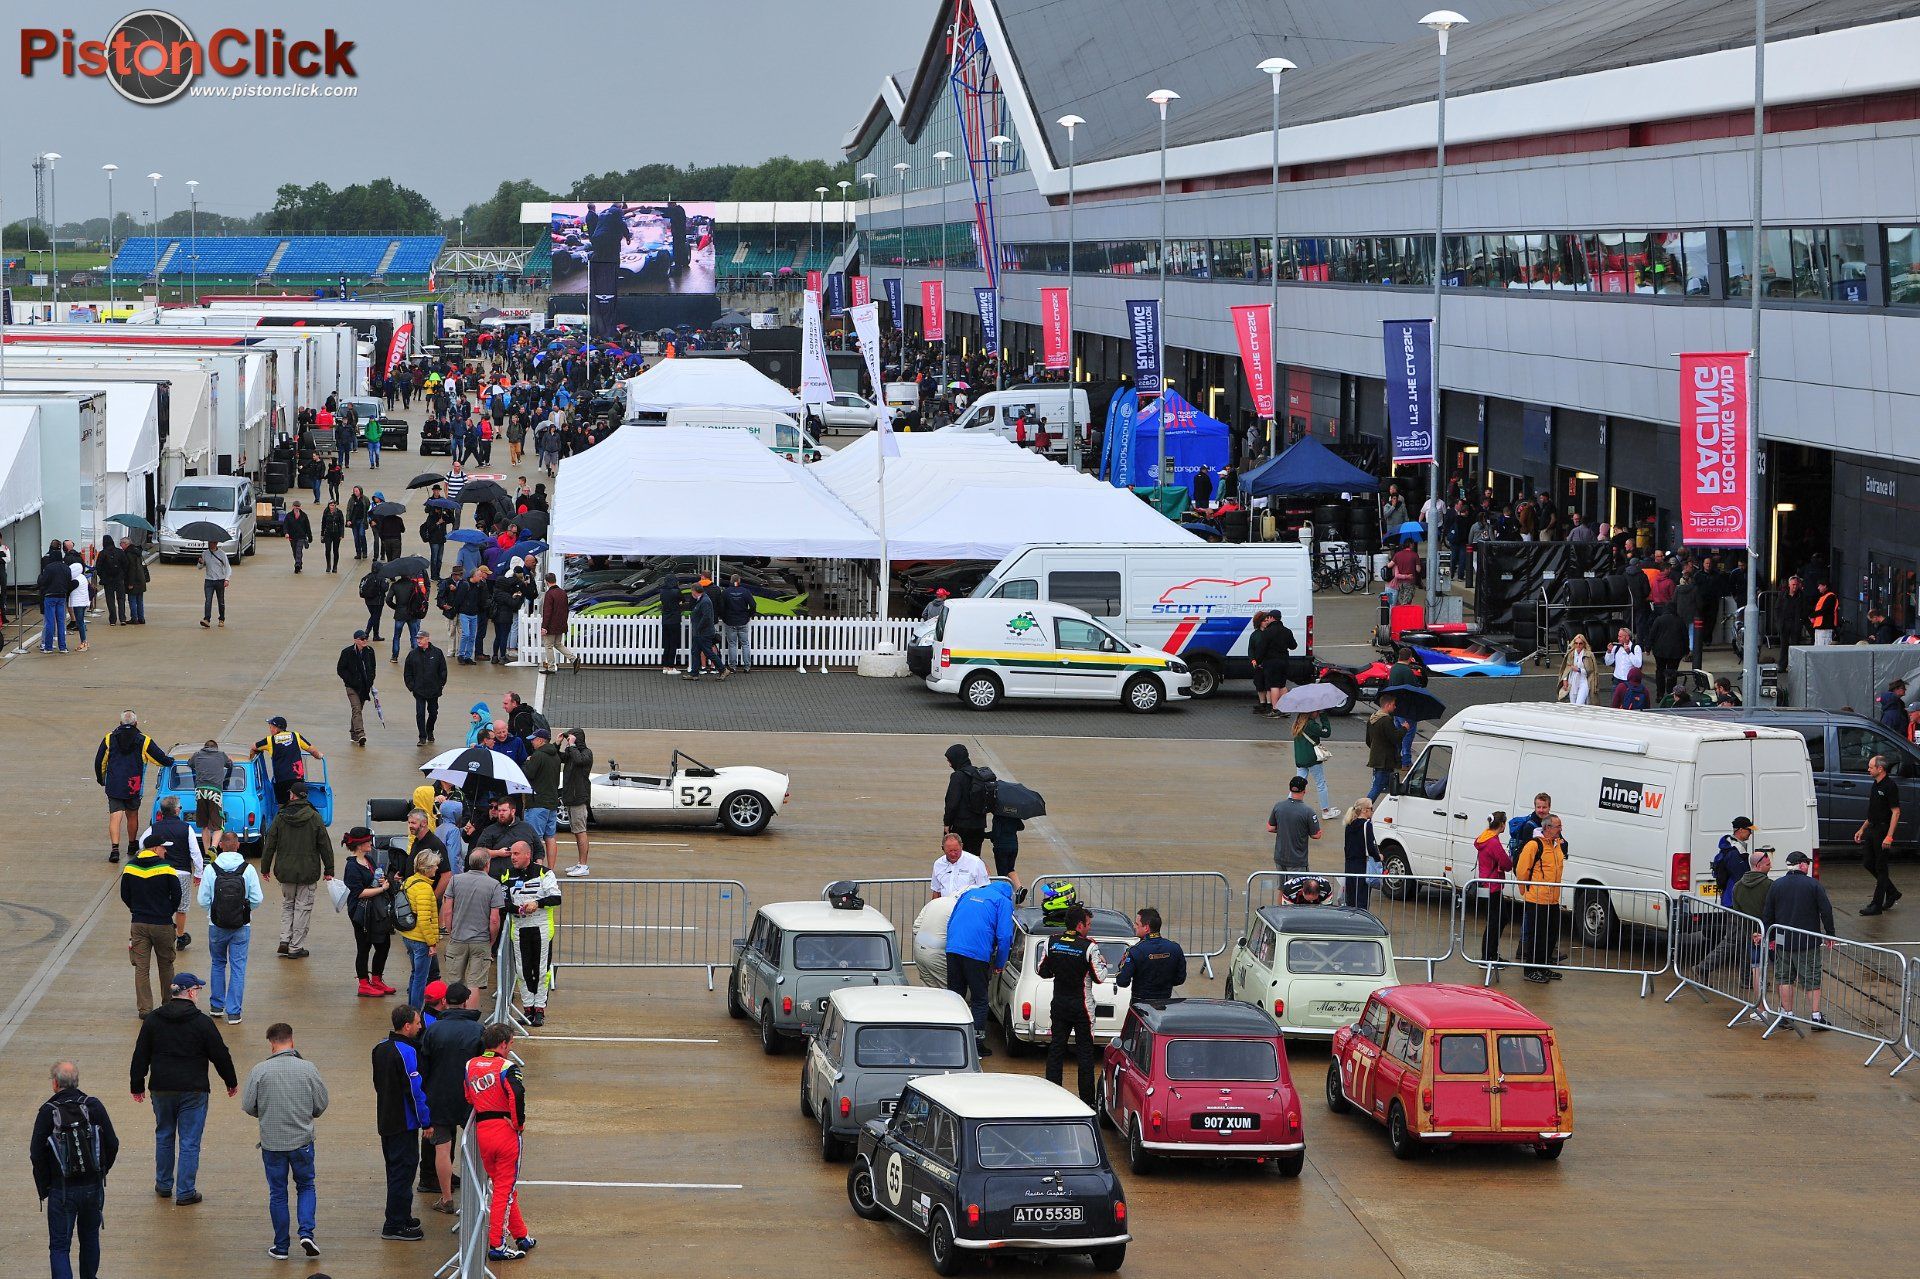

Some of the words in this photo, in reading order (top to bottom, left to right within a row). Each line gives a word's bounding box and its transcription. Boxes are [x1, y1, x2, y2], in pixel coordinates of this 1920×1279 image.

[1599, 425, 1606, 445] 31
[1120, 419, 1130, 473] motorsport
[1757, 451, 1767, 475] 33
[1865, 475, 1888, 496] Entrance
[1888, 480, 1896, 497] 01
[680, 786, 712, 807] 52
[1611, 801, 1637, 811] engineering
[1316, 1001, 1336, 1012] Mac
[1337, 1001, 1361, 1013] Tools
[1352, 1049, 1372, 1104] 77
[1204, 1117, 1222, 1129] 907
[1226, 1117, 1252, 1129] XUM
[888, 1162, 901, 1194] 55
[1016, 1208, 1043, 1221] ATO
[1045, 1207, 1082, 1221] 553B
